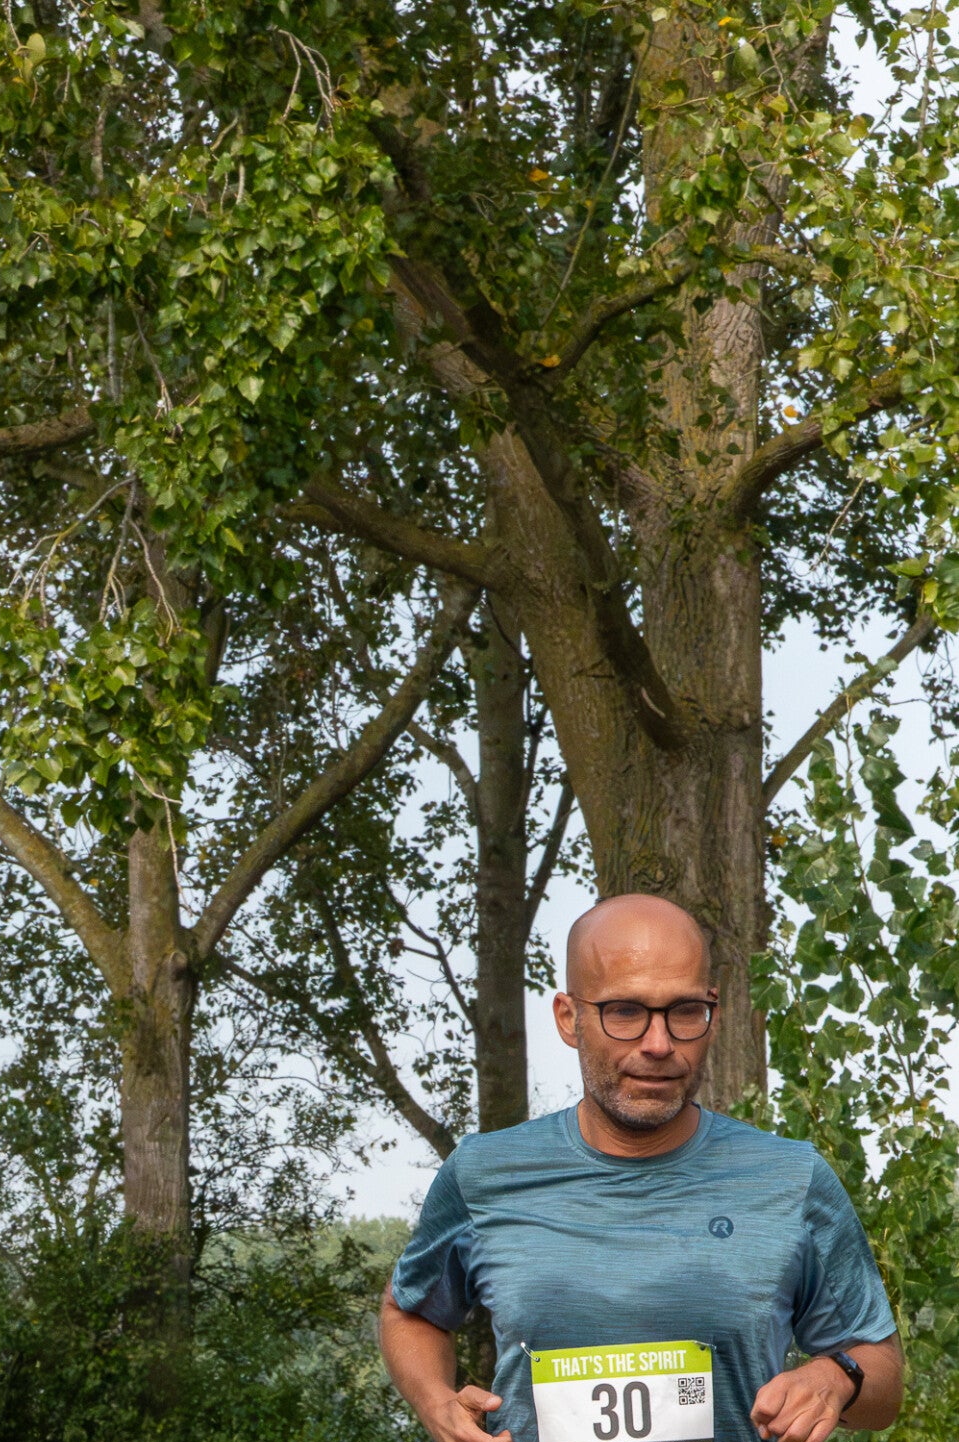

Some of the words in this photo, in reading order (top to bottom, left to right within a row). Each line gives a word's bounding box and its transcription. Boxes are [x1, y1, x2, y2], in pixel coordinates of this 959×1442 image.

[551, 1355, 603, 1378] THAT'S
[606, 1353, 636, 1373] THE
[639, 1350, 686, 1371] SPIRIT
[591, 1381, 652, 1441] 30
